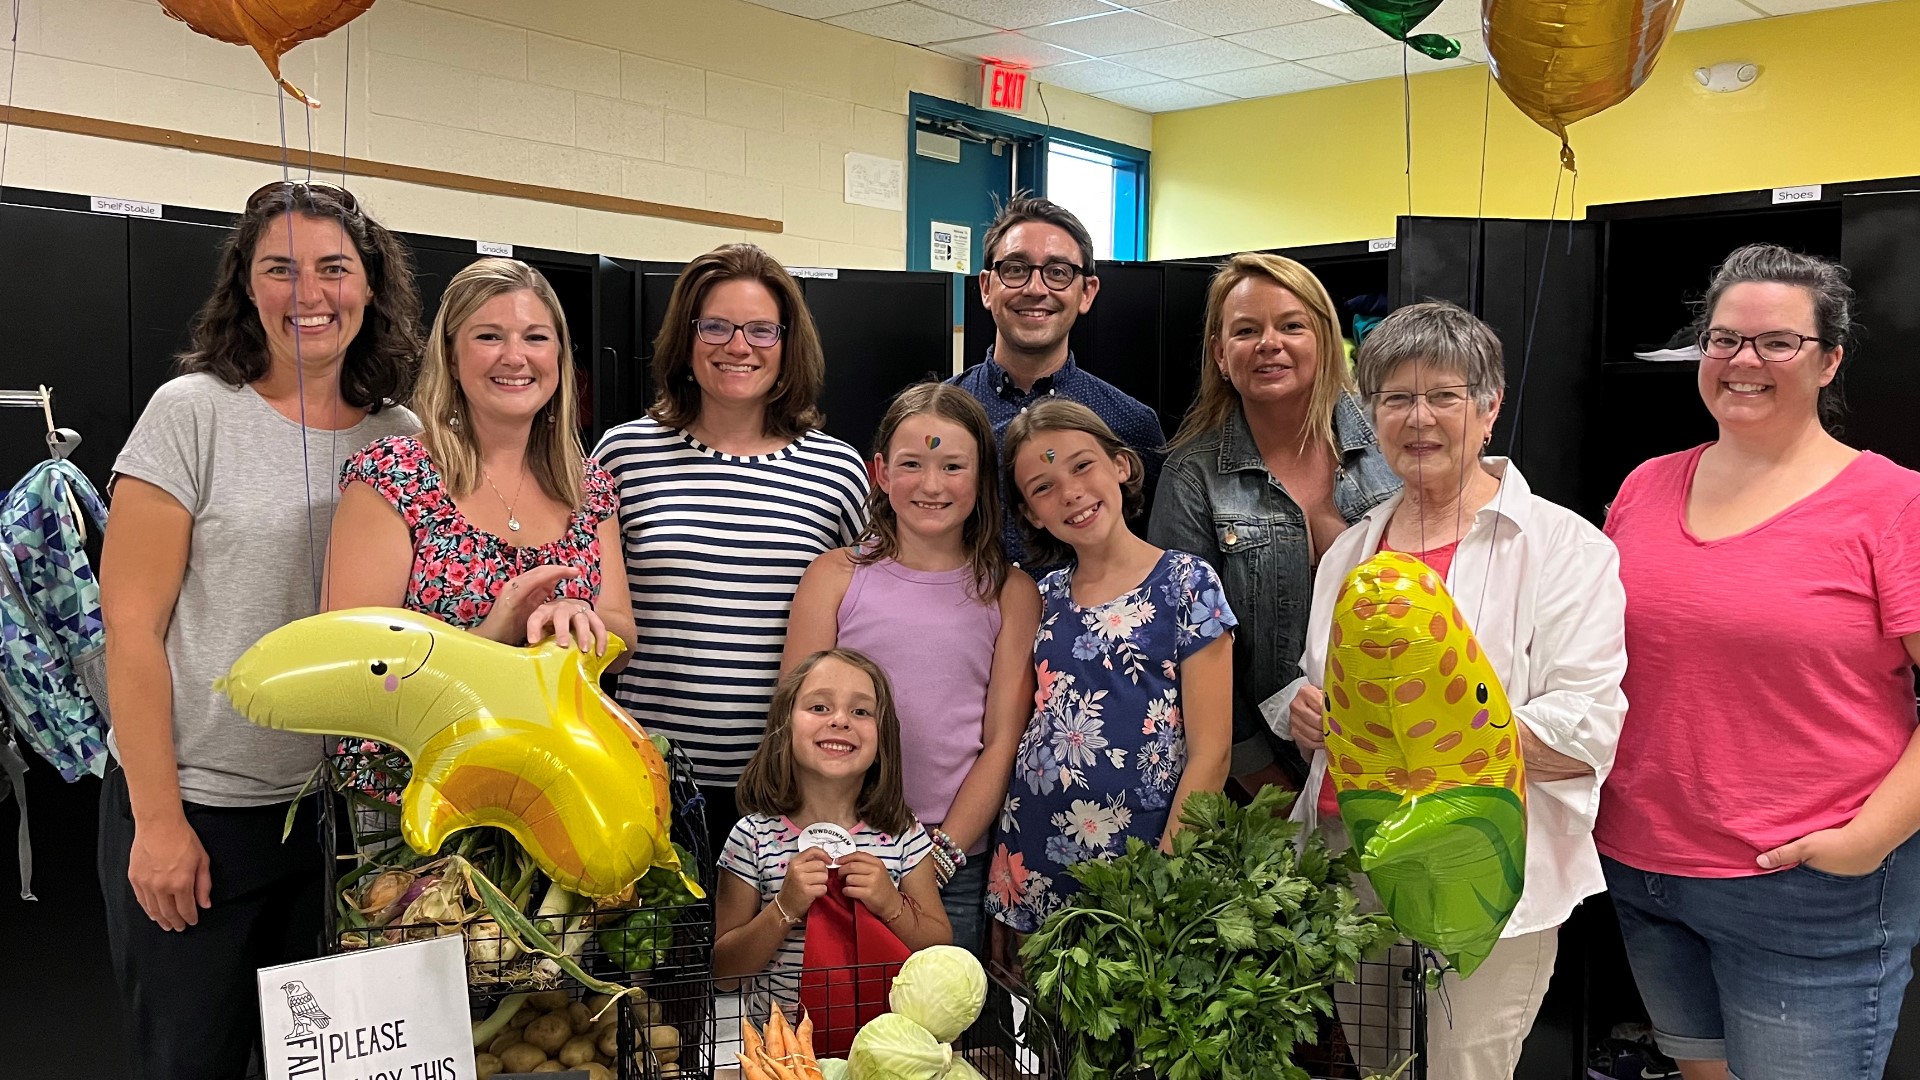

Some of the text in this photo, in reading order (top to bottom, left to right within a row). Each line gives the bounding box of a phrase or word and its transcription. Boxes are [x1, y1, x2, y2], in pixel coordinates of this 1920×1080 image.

[991, 69, 1026, 111] EXIT
[1778, 191, 1814, 200] Shoes
[97, 200, 155, 215] Shelf Stable
[482, 244, 509, 255] Snacks
[329, 1019, 407, 1063] PLEASE
[410, 1057, 456, 1080] THIS
